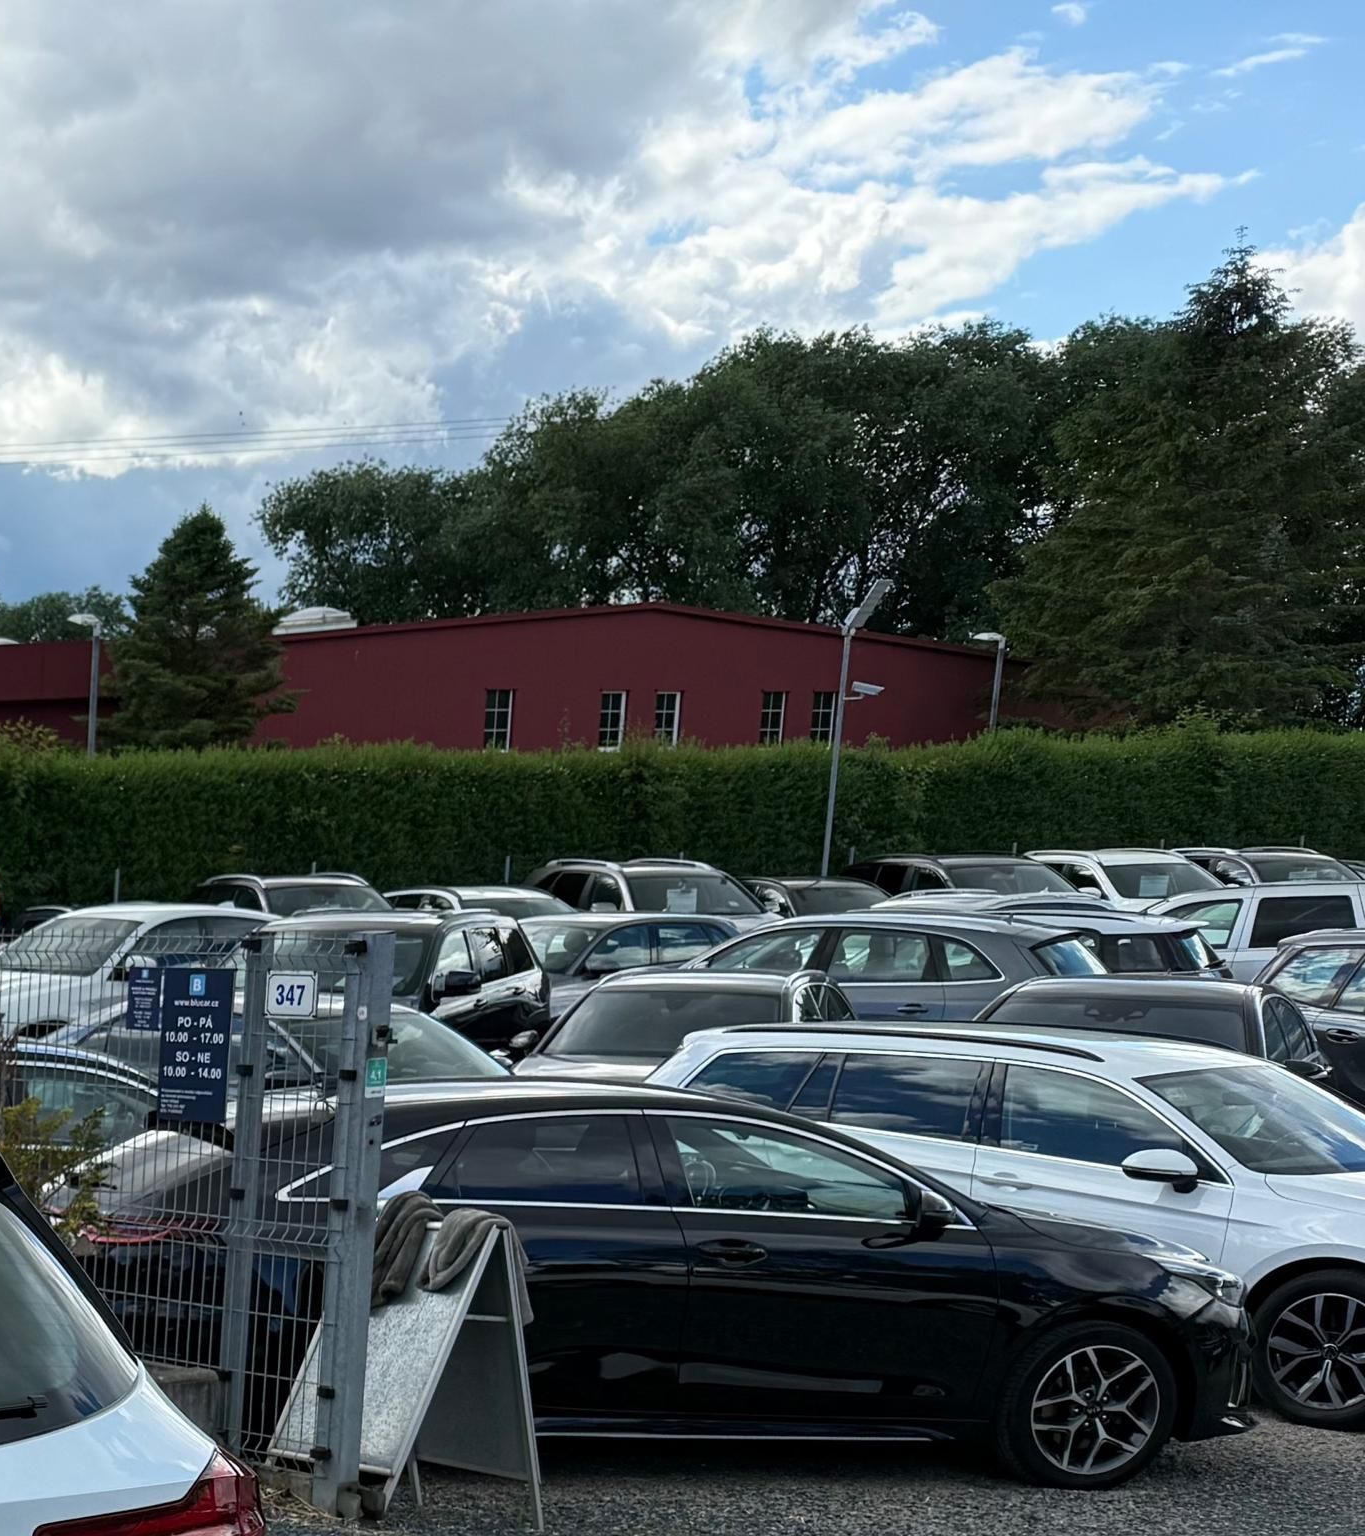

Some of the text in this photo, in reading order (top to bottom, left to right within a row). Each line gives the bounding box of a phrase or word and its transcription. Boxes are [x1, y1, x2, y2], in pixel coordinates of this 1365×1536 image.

[192, 978, 202, 991] B
[275, 983, 306, 1006] 347
[174, 998, 219, 1008] www.blucar.cz
[177, 1016, 192, 1028] PO
[199, 1013, 213, 1029] PÁ
[165, 1031, 189, 1043] 10.00
[200, 1032, 224, 1045] 17.00
[175, 1051, 190, 1063] SO
[197, 1052, 211, 1064] NE
[163, 1065, 187, 1077] 10.00
[198, 1067, 222, 1079] 14.00
